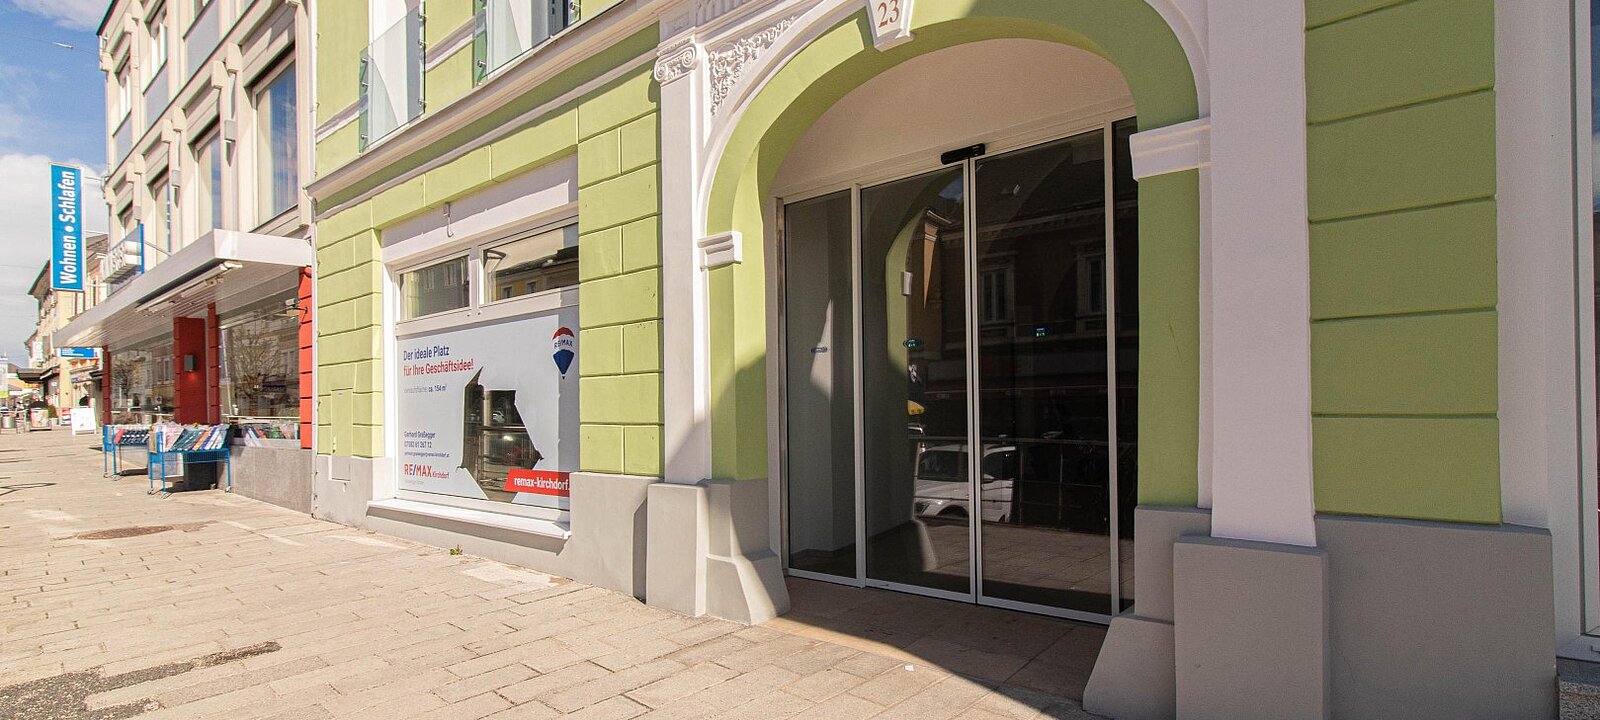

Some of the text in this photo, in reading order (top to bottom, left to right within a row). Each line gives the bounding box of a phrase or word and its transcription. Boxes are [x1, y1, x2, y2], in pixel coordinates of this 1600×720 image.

[877, 0, 899, 27] 23
[57, 170, 77, 284] Wohnen Schlafen
[403, 345, 450, 361] Der ideale Platz
[403, 358, 474, 376] für Ihre Geschäftsidee!
[404, 463, 432, 477] RE/MAX
